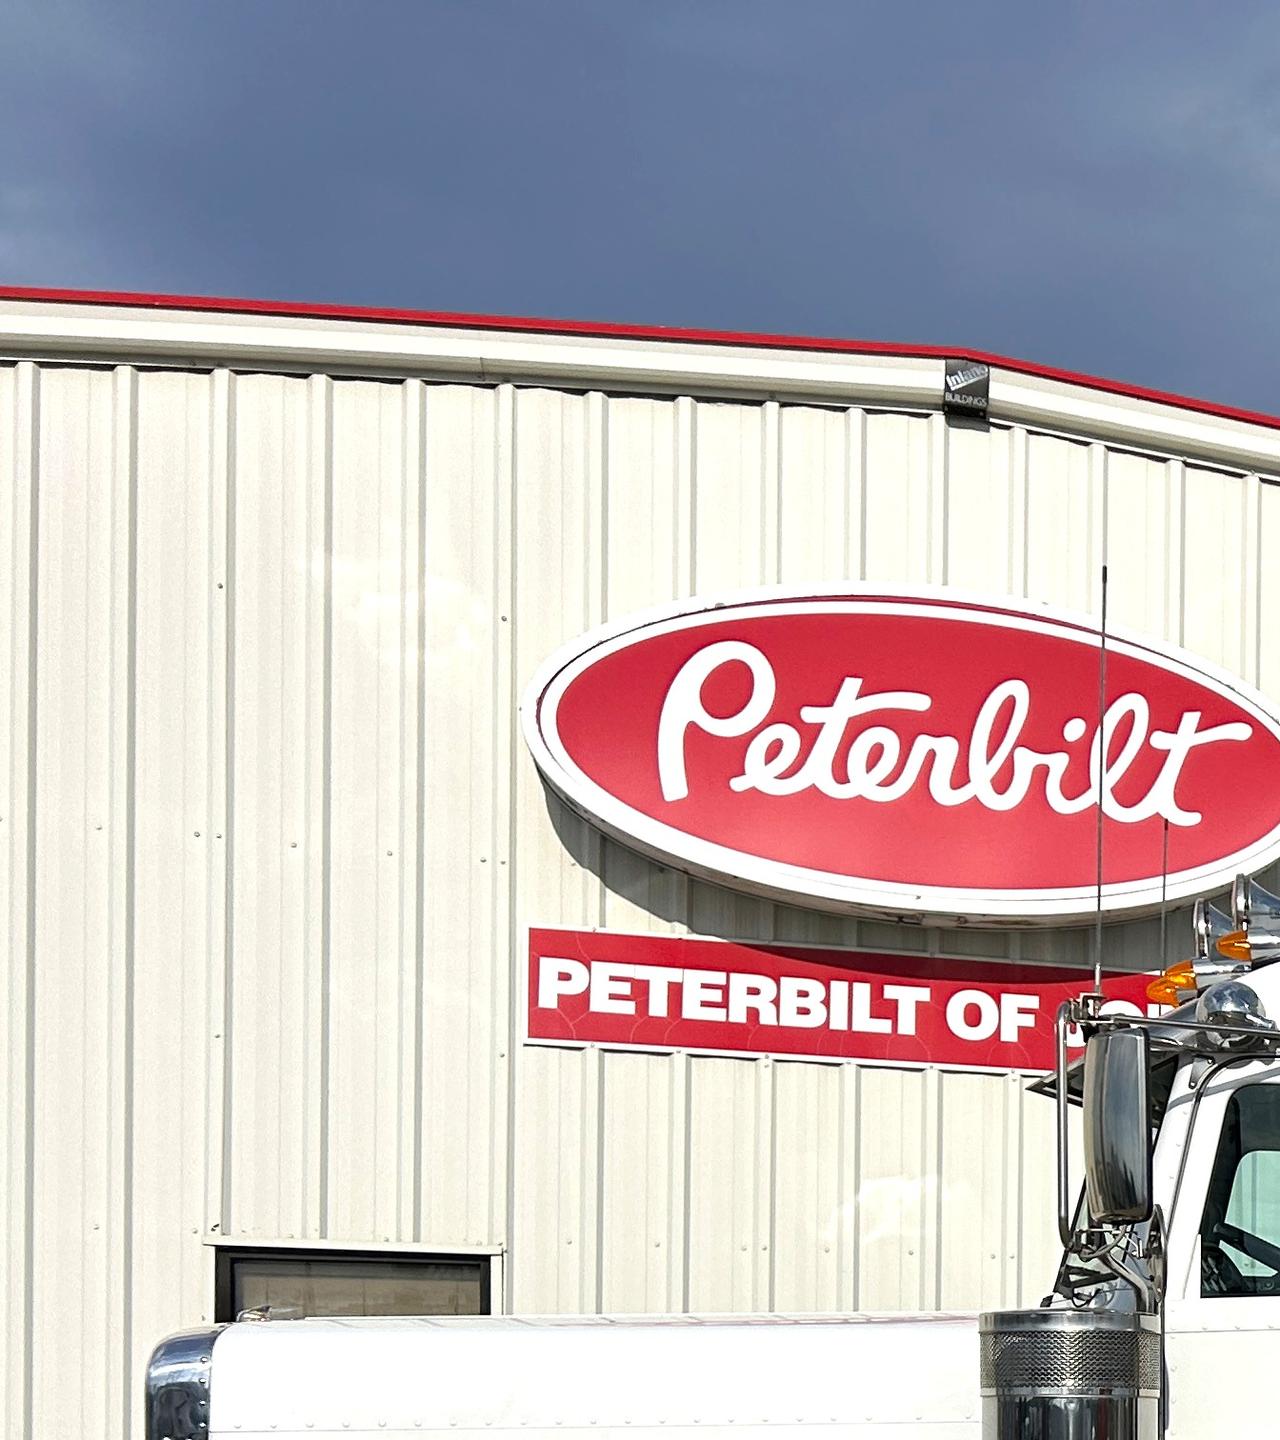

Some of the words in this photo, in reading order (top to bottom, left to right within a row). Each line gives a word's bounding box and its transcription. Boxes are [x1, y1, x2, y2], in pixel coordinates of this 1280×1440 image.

[658, 641, 1252, 827] Peterbilt
[538, 956, 931, 1036] PETERBILT
[946, 989, 1040, 1043] OF
